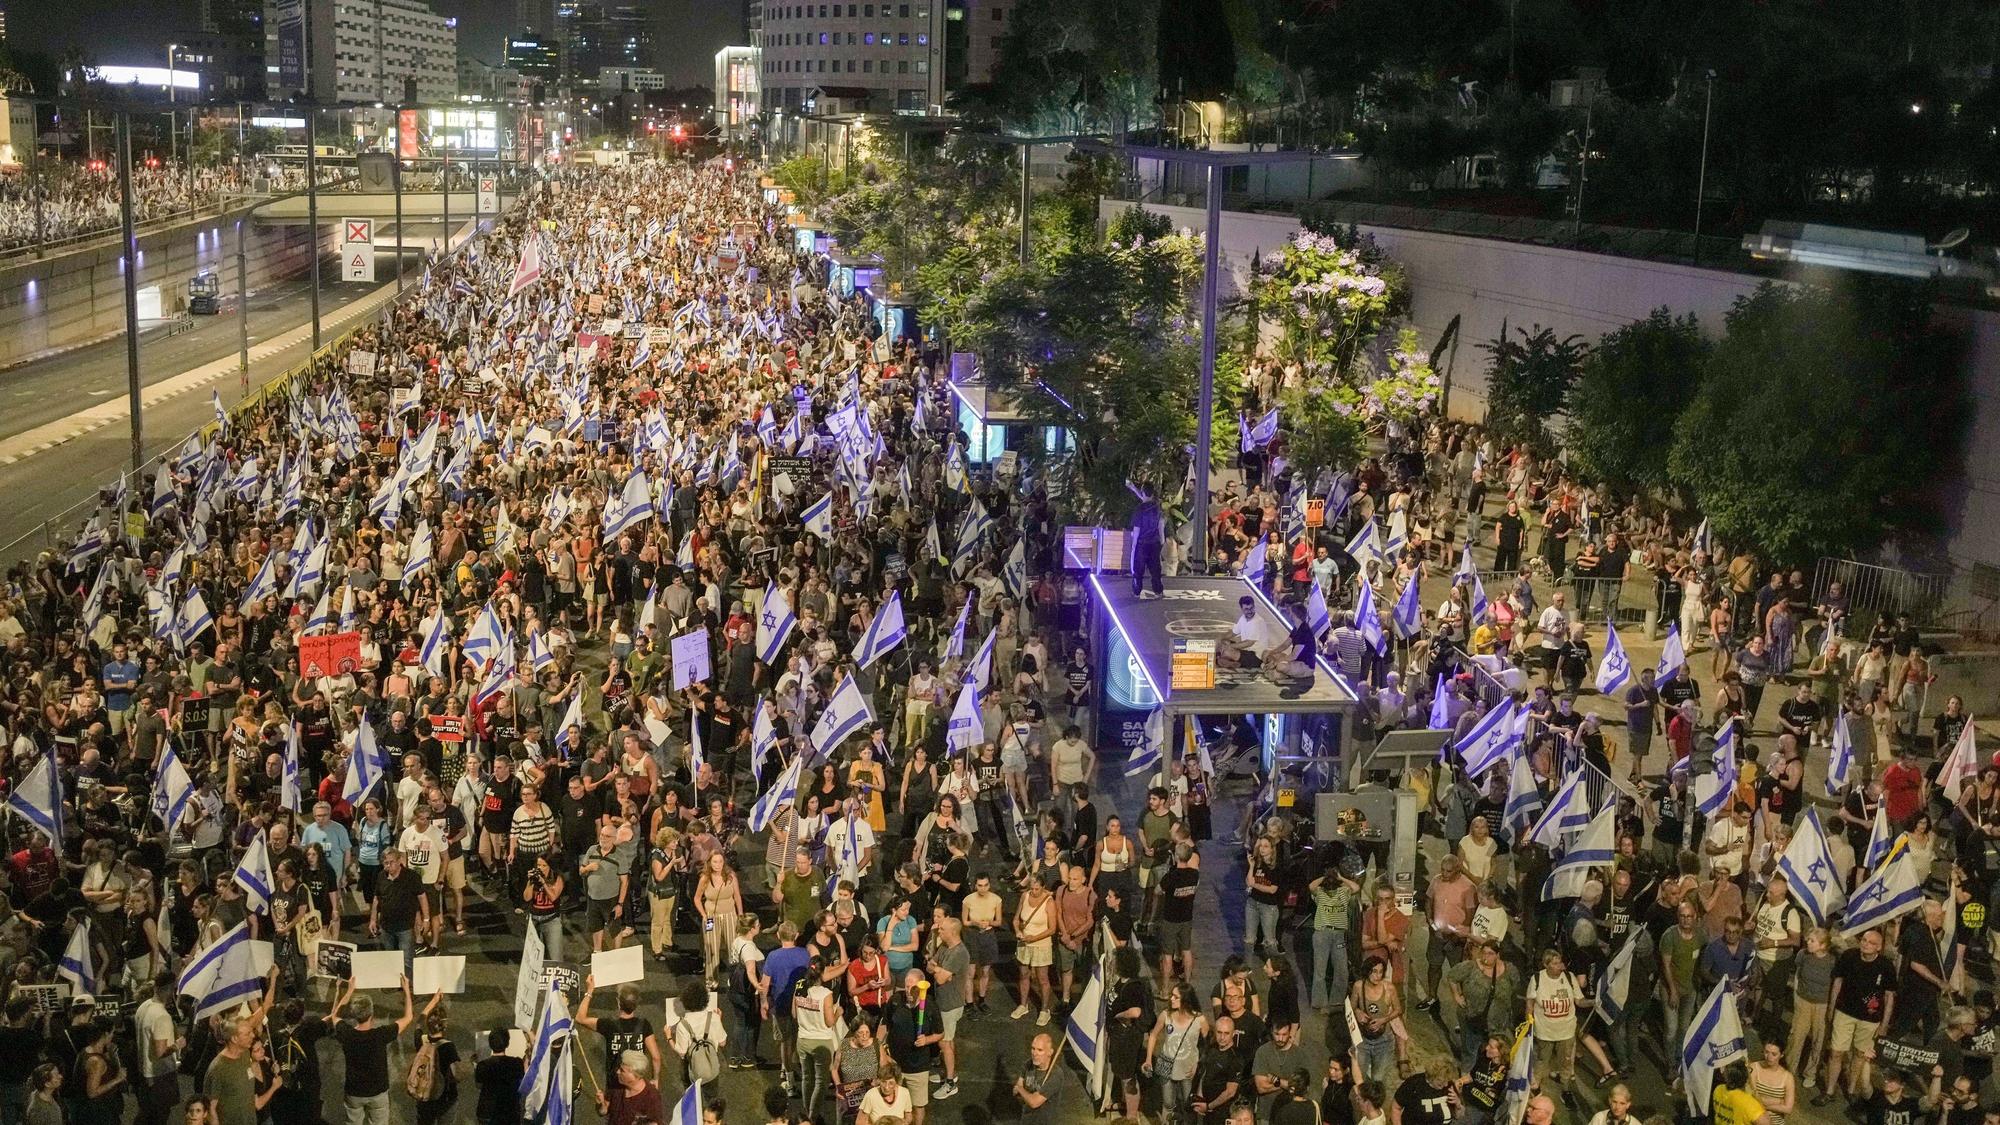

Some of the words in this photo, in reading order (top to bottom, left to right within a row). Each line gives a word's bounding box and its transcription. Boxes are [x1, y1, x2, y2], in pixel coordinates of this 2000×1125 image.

[801, 458, 811, 467] לא
[1307, 500, 1323, 510] 7.10
[546, 966, 570, 975] שלום
